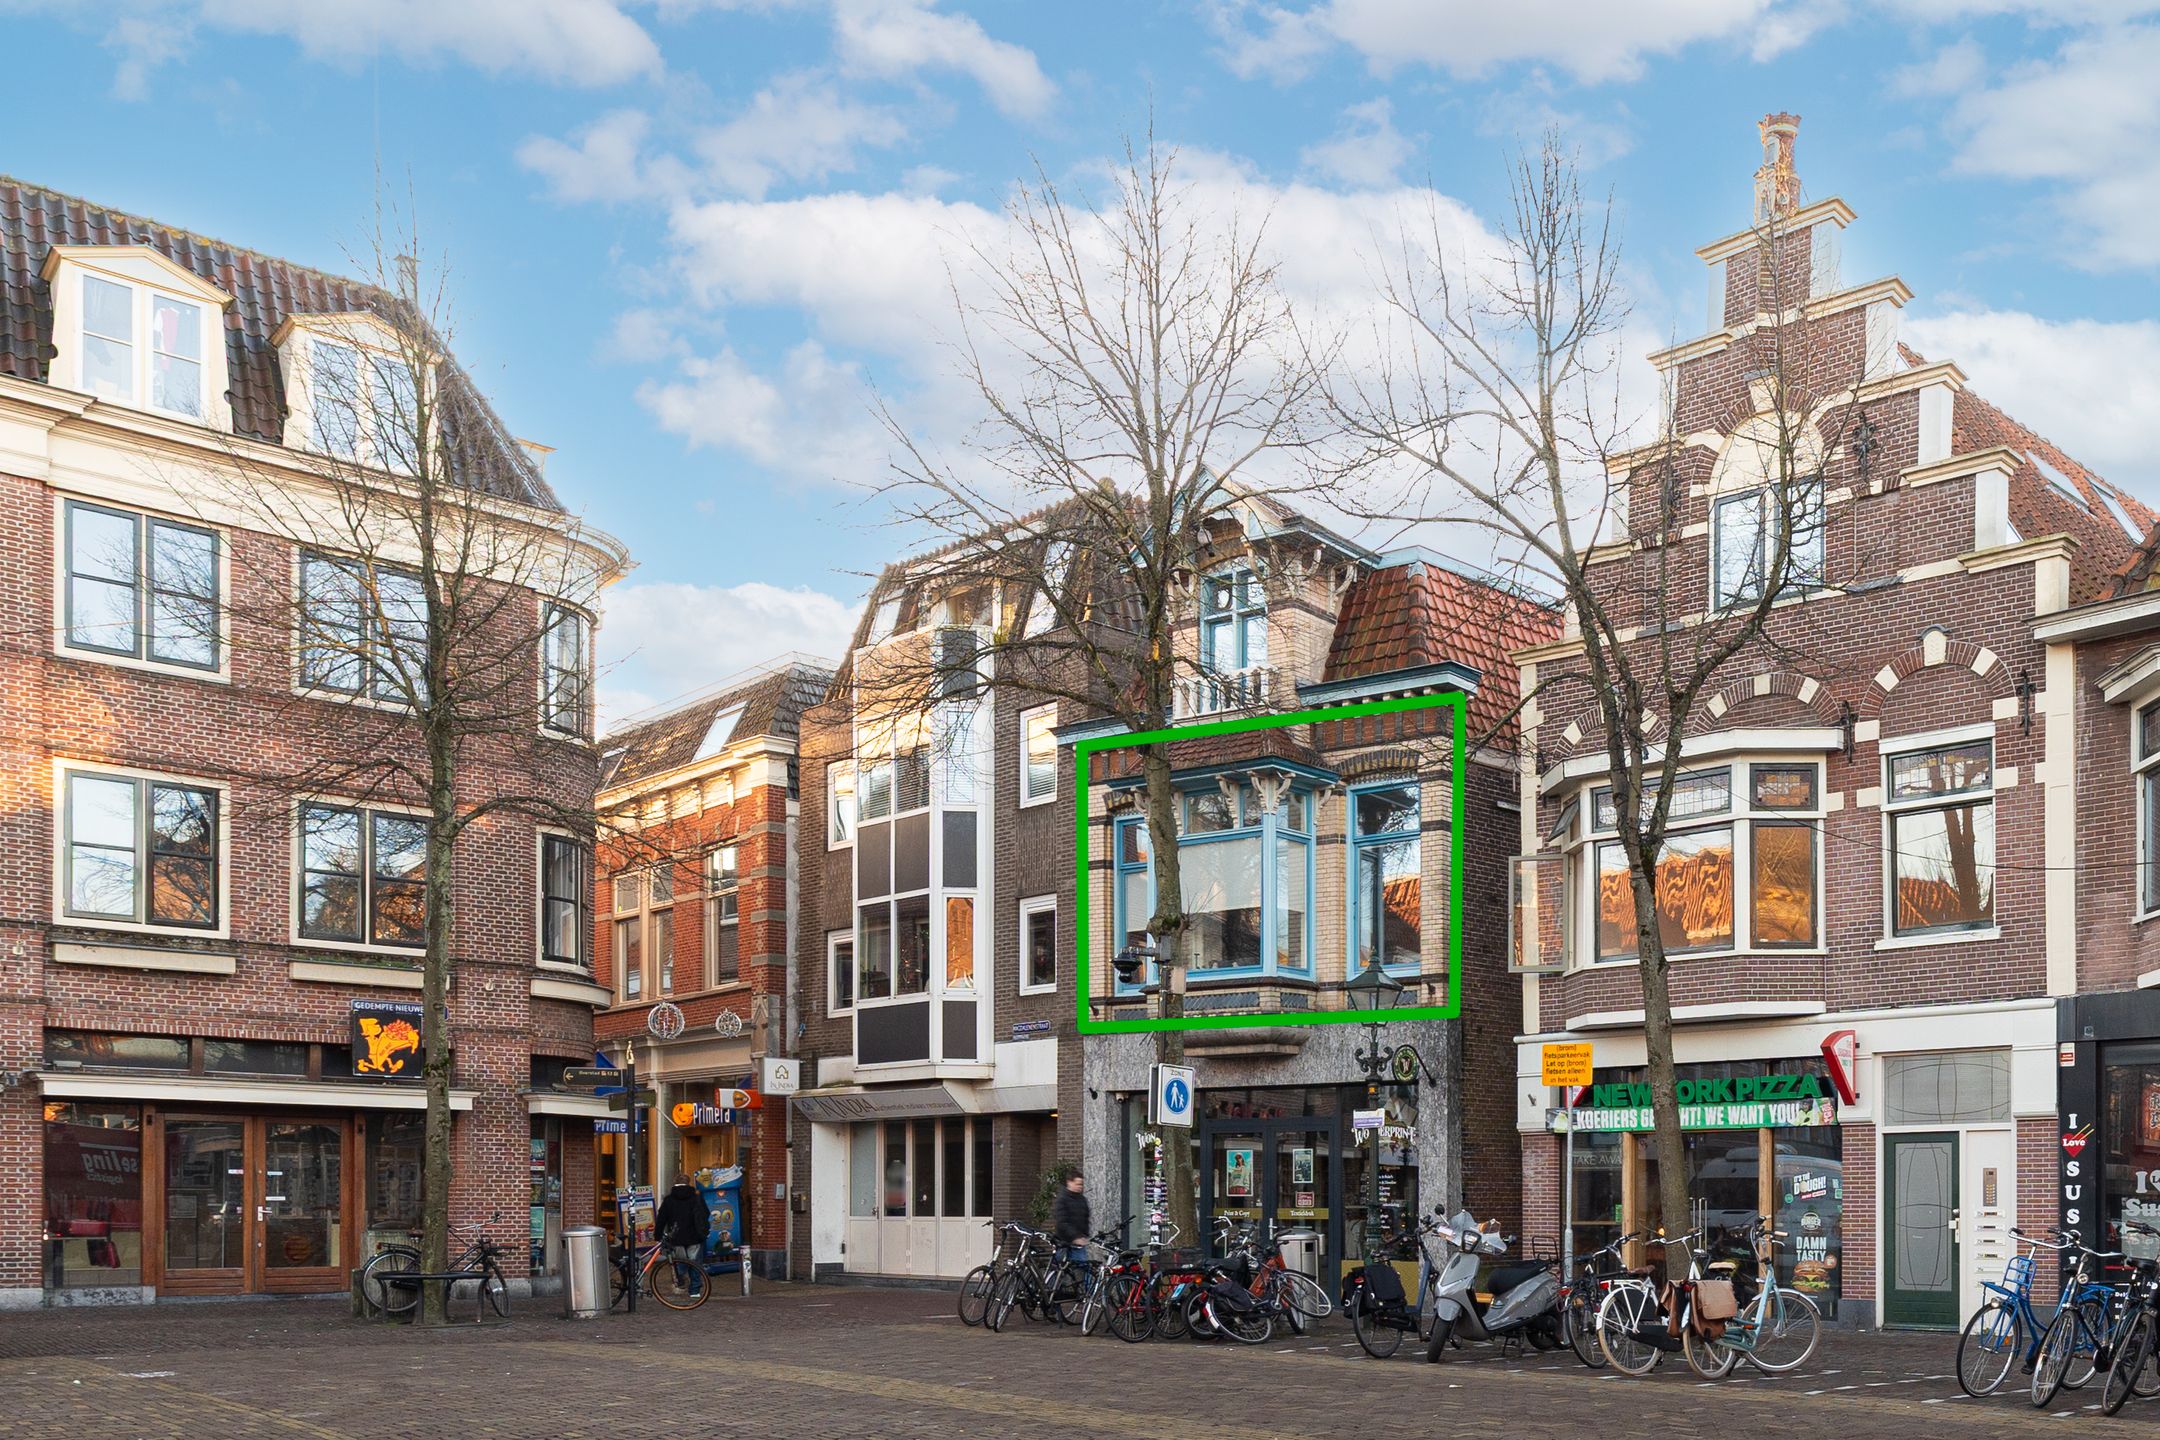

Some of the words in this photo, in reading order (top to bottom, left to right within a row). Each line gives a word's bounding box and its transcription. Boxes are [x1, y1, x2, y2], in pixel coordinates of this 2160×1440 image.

[354, 1001, 393, 1011] GEDEMPTE
[395, 1004, 424, 1013] NIEUWE
[1594, 1082, 1652, 1107] NEW
[1675, 1078, 1734, 1104] ORK
[1736, 1073, 1822, 1100] PIZZA
[693, 1103, 730, 1125] Primera
[1576, 1109, 1638, 1129] KOERIERS
[1705, 1106, 1724, 1126] WE
[1728, 1104, 1765, 1125] WANT
[2068, 1113, 2078, 1129] I
[2062, 1138, 2086, 1147] Love
[1599, 1153, 1622, 1165] AWA
[1796, 1236, 1827, 1249] DAMN
[1796, 1250, 1826, 1262] TASTY
